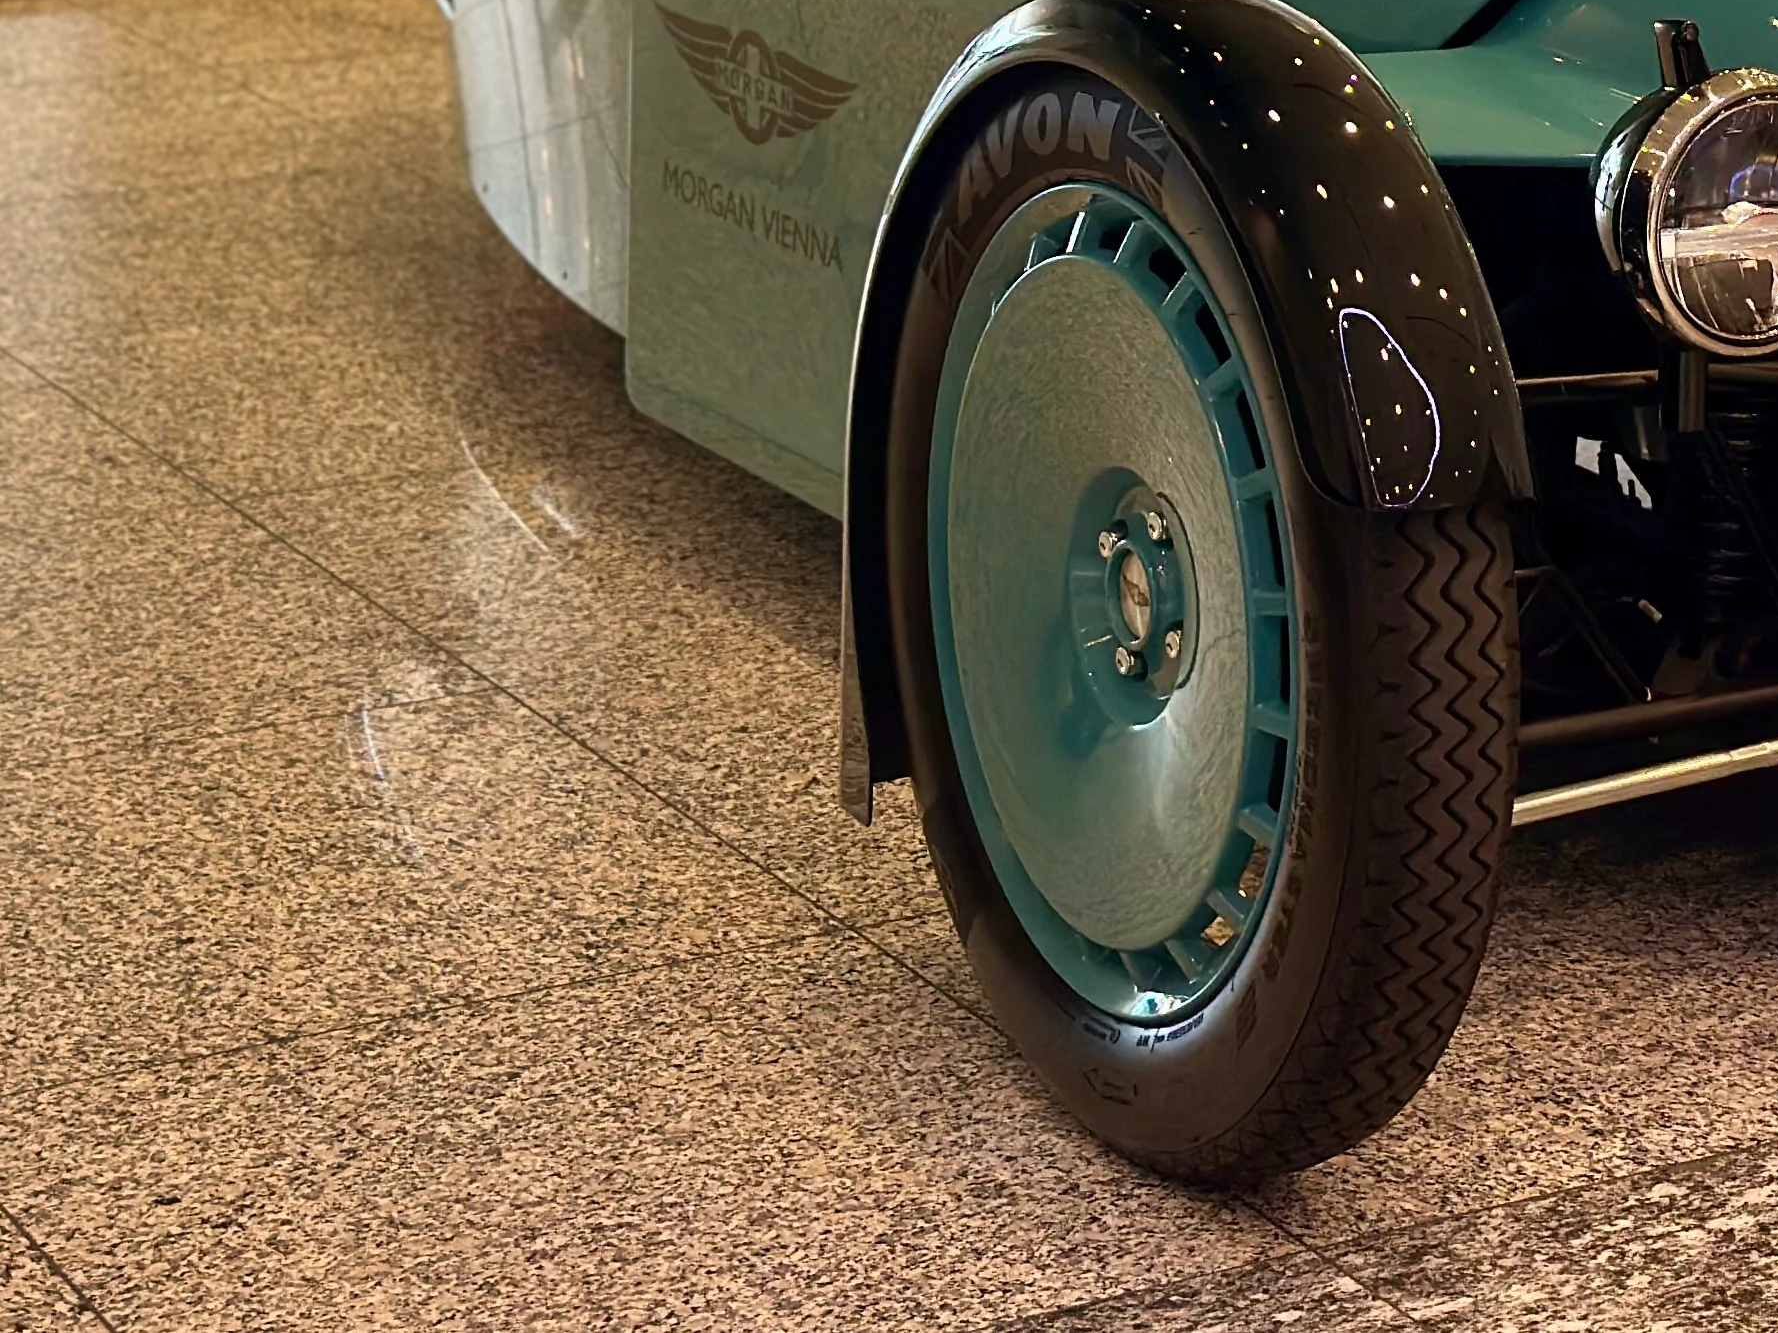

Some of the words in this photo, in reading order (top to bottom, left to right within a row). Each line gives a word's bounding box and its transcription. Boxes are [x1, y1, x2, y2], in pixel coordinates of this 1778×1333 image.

[714, 58, 794, 112] MORGAN
[957, 91, 1120, 224] AVON
[662, 160, 755, 233] MORGAN
[761, 206, 843, 274] VIENNA
